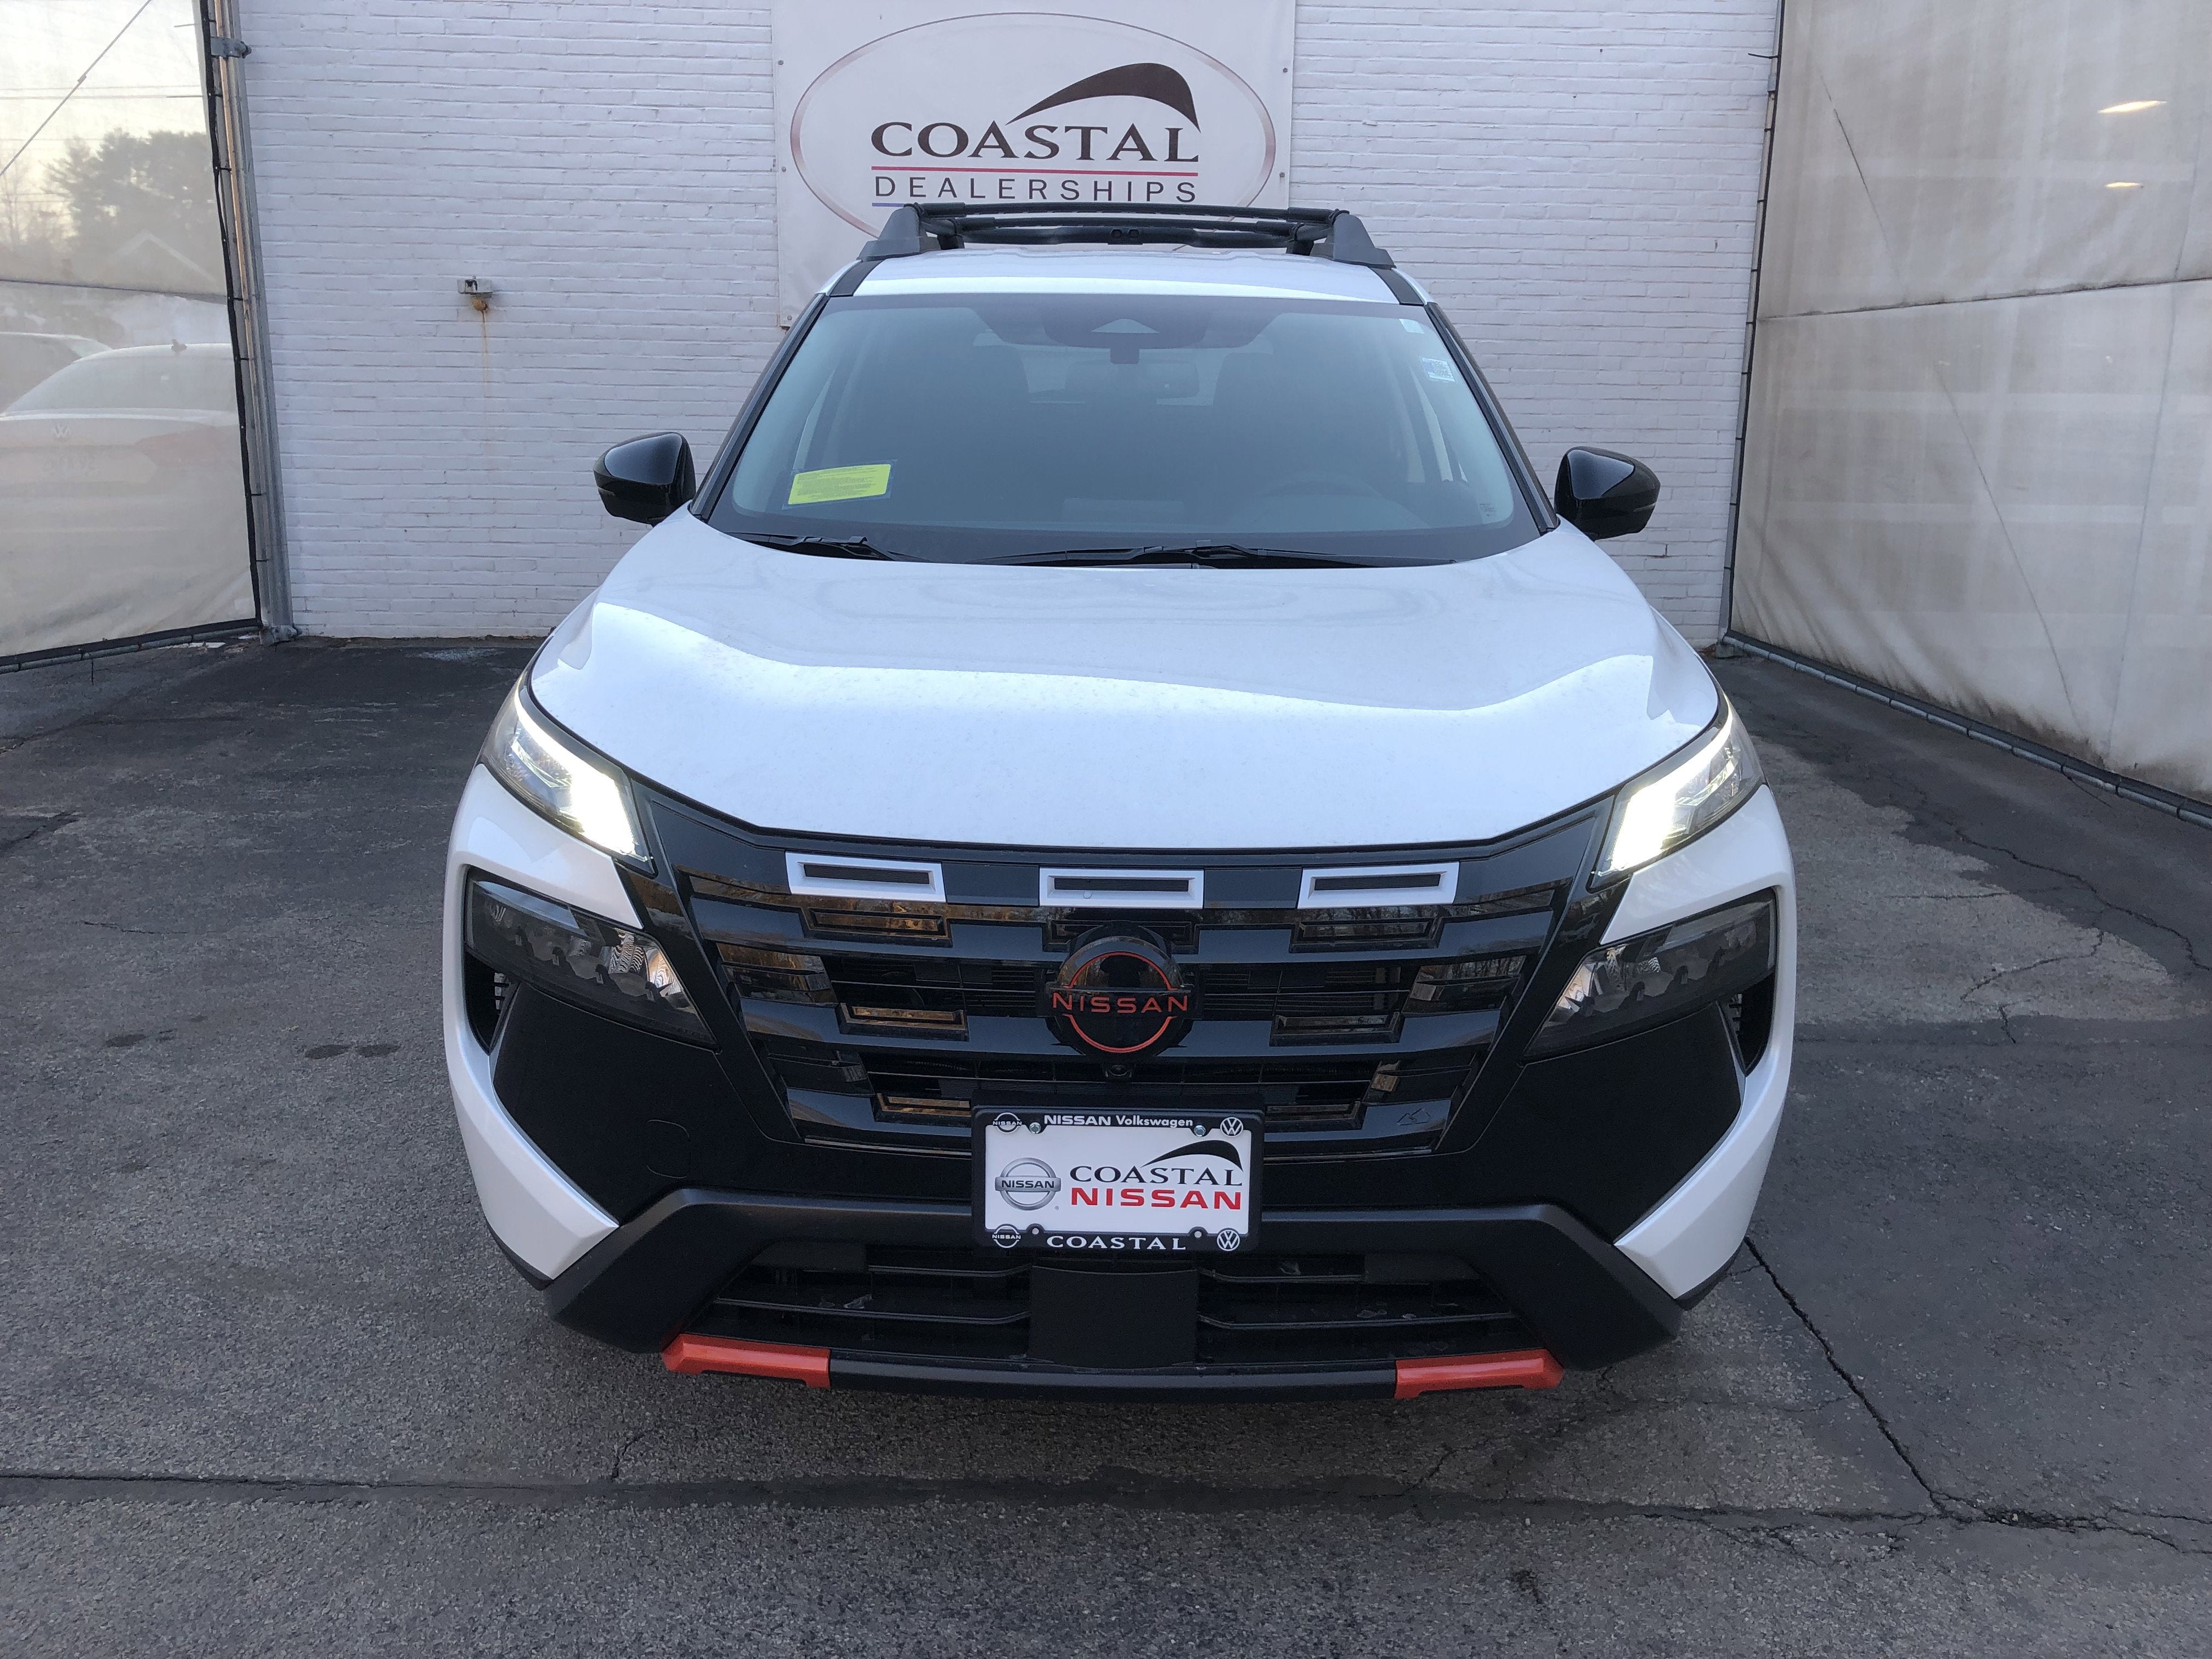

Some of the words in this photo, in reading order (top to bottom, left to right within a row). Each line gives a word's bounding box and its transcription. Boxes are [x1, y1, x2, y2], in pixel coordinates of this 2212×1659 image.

[871, 120, 1199, 162] COASTAL
[875, 176, 1197, 203] DEALERSHIPS
[1052, 991, 1188, 1014] NISSAN
[1044, 1115, 1111, 1126] NISSAN
[1115, 1115, 1194, 1128] Volkswagen
[1001, 1180, 1054, 1188] NISSAN
[1070, 1165, 1243, 1186] COASTAL
[1071, 1187, 1241, 1210] NISSAN
[1047, 1235, 1186, 1250] COASTAL
